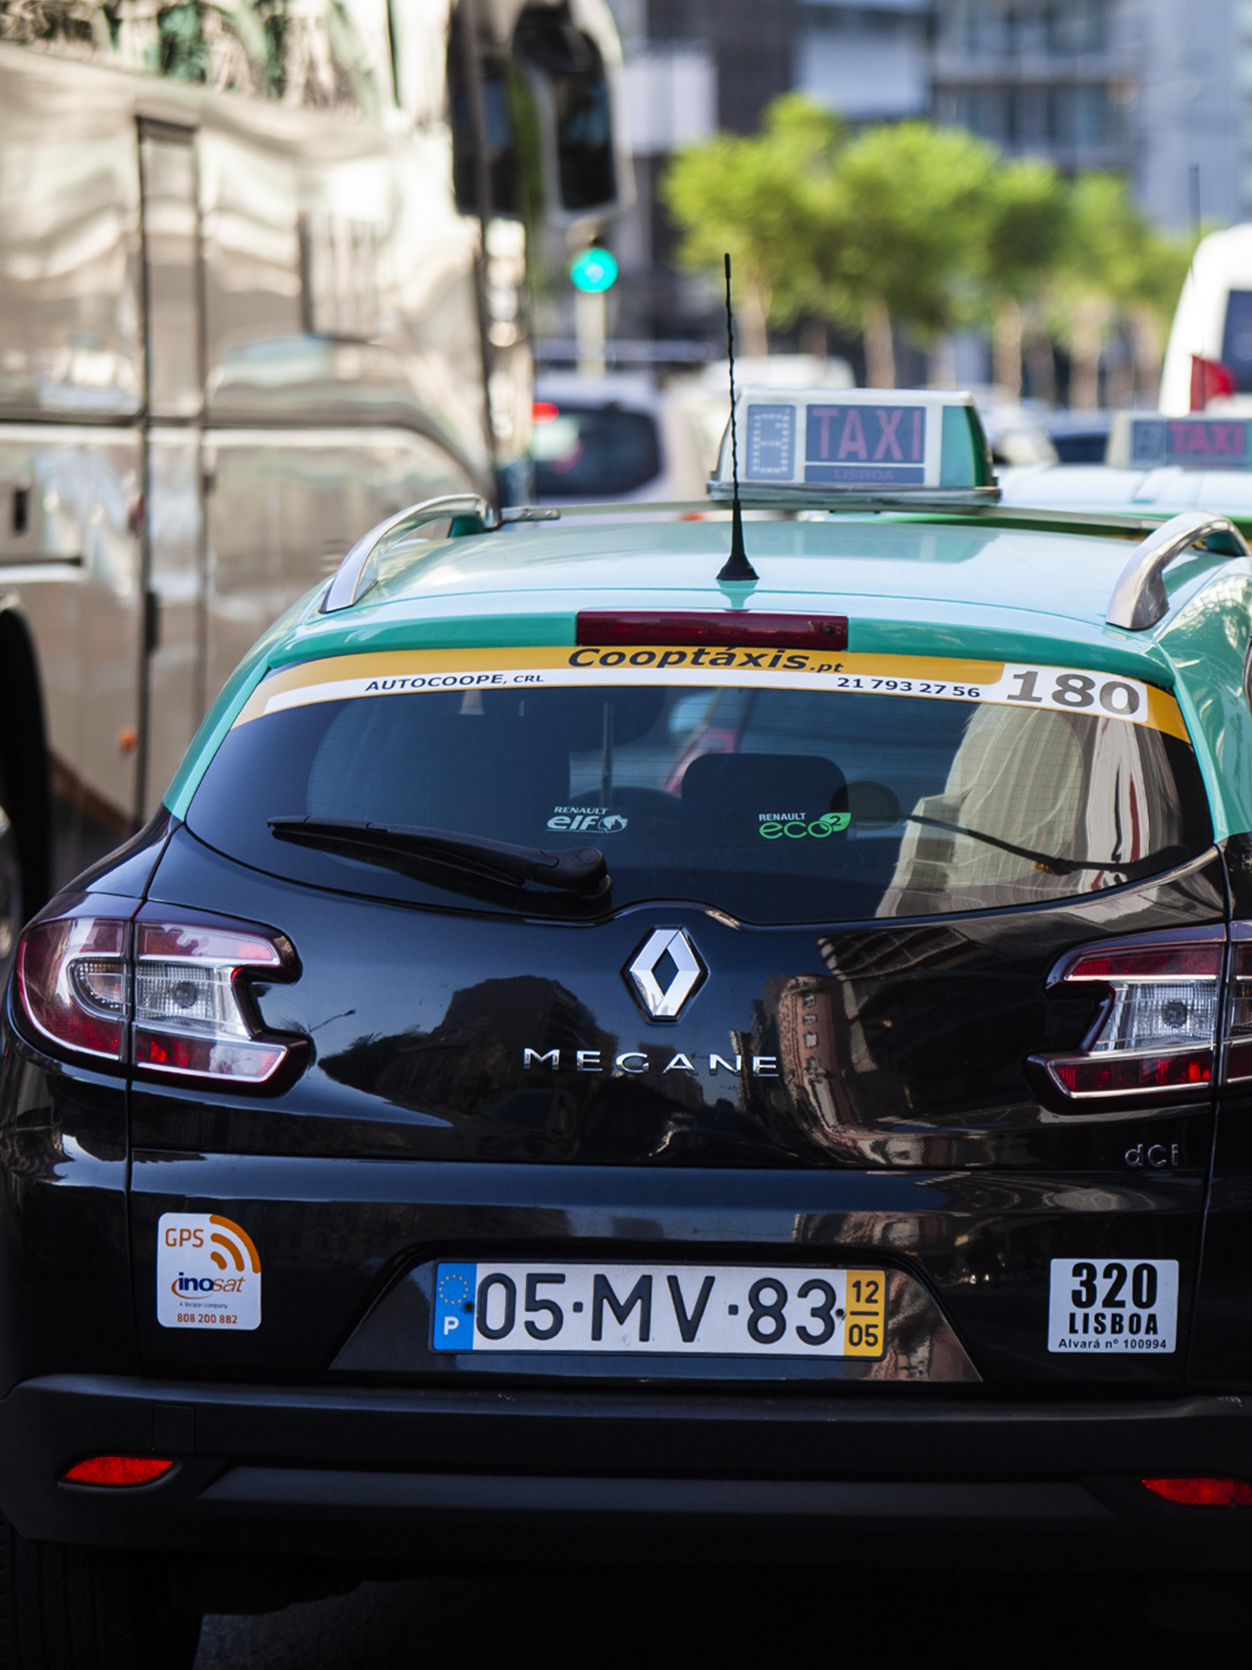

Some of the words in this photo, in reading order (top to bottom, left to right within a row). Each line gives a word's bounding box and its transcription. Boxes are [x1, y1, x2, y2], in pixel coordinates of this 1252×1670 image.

[812, 408, 922, 461] TAXI
[1168, 421, 1244, 455] TAXI
[834, 469, 895, 481] LISBOA
[568, 647, 845, 673] Cooptáxis.pt
[365, 674, 508, 692] AUTOCOOPE,
[513, 675, 545, 683] CRL
[837, 677, 864, 688] 21
[871, 679, 912, 691] 793
[919, 683, 946, 694] 27
[952, 686, 980, 698] 56
[1006, 671, 1141, 716] 180
[554, 806, 609, 815] RENAULT
[759, 812, 806, 821] RENAULT
[547, 815, 599, 830] elf
[524, 1048, 779, 1078] MEGANE
[1124, 1143, 1179, 1168] dCi
[165, 1228, 204, 1248] GPS
[178, 1272, 246, 1292] inosat
[852, 1280, 879, 1304] 12
[1071, 1262, 1158, 1310] 320
[177, 1313, 196, 1323] 808
[198, 1313, 217, 1324] 200
[219, 1314, 238, 1325] 882
[443, 1316, 460, 1335] P
[1069, 1313, 1158, 1335] LISBOA
[849, 1323, 879, 1347] 05
[1059, 1338, 1100, 1348] Alvará
[1123, 1339, 1167, 1349] 100994
